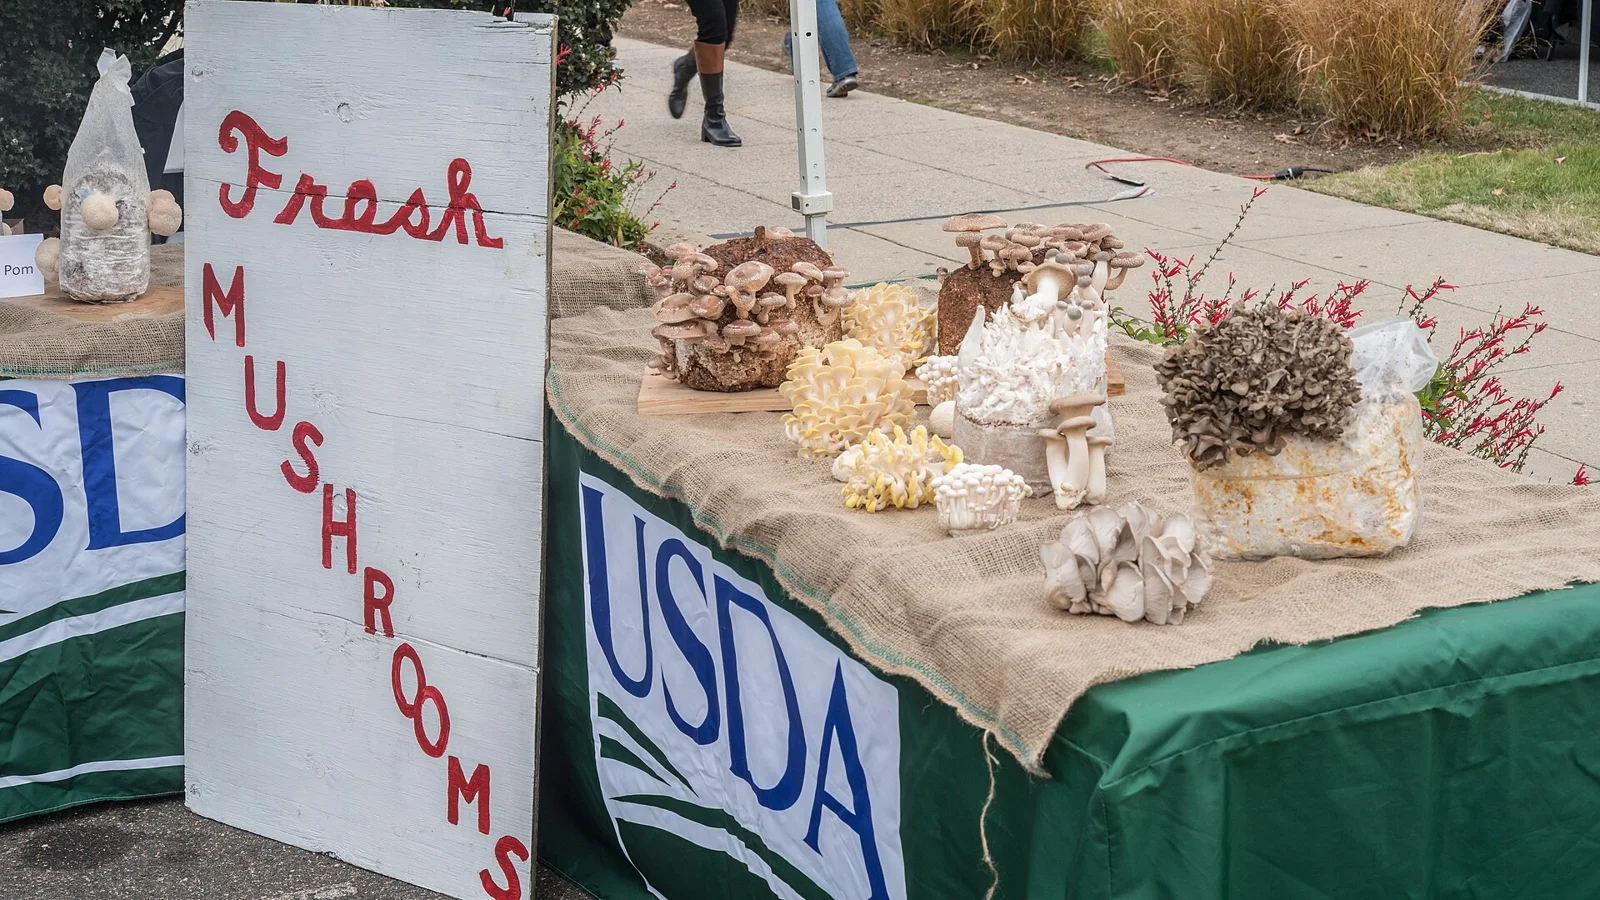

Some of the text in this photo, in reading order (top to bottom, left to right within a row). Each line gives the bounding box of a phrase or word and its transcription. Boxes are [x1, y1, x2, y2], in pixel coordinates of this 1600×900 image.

[4, 264, 34, 276] Pom
[219, 111, 503, 248] Fresh
[204, 264, 529, 900] MUSHROOMS
[580, 484, 891, 900] USDA
